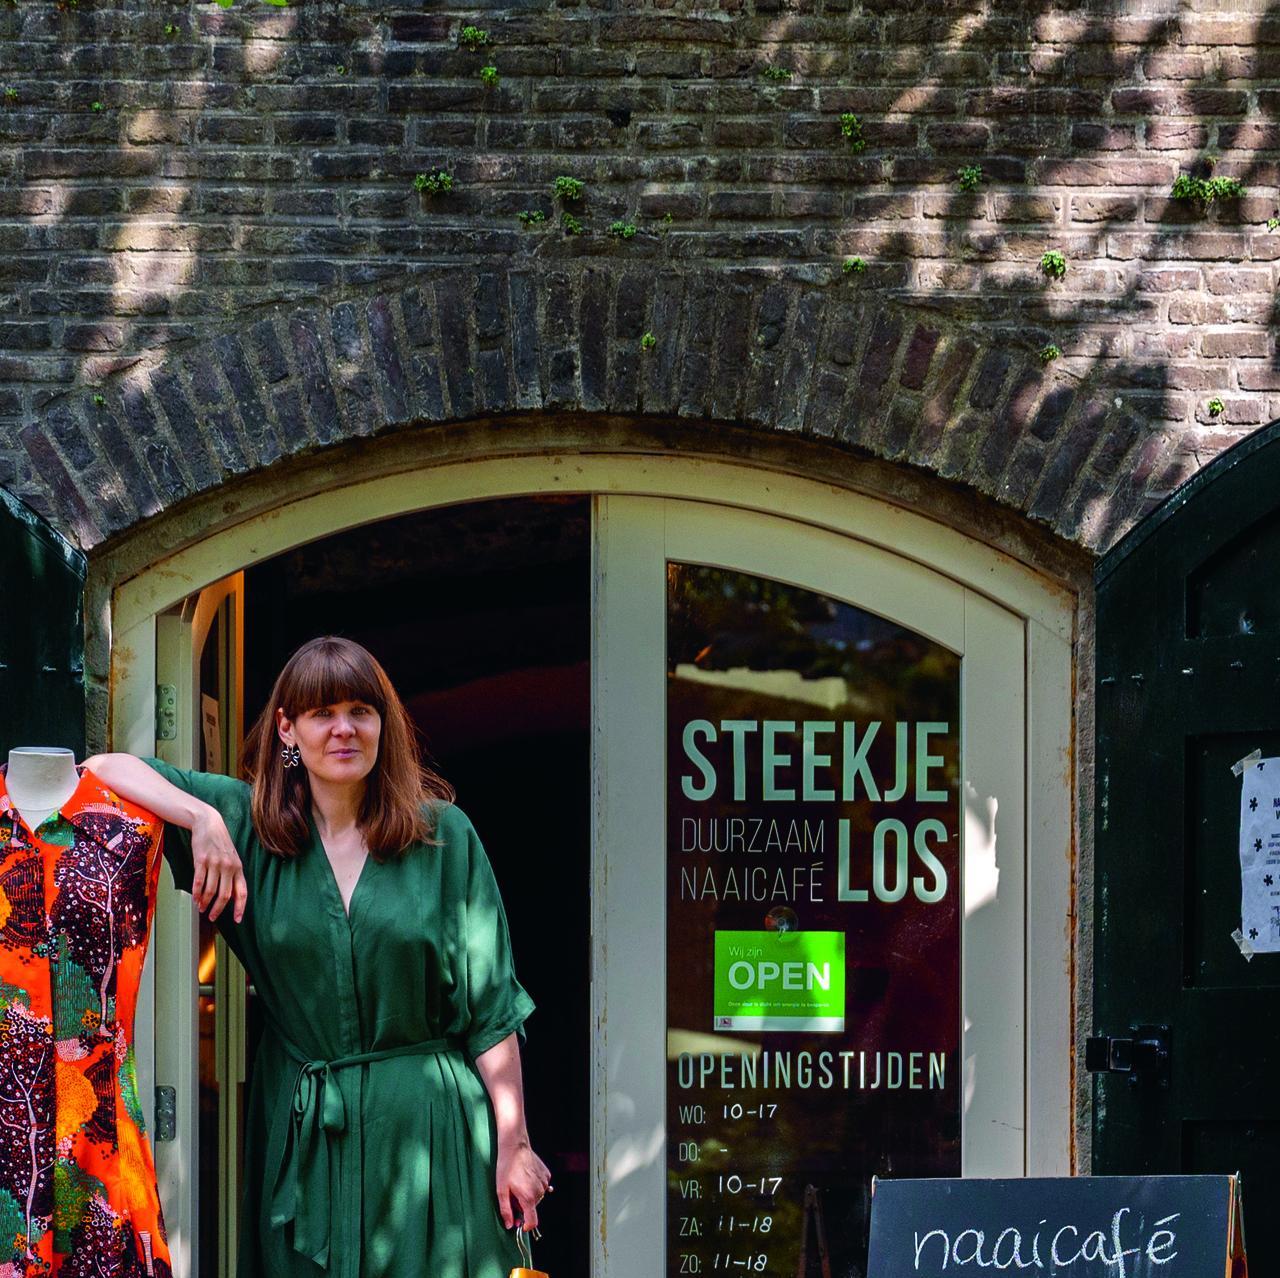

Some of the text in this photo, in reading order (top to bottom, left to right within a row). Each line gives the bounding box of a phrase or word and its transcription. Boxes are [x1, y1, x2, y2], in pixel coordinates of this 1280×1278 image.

[681, 719, 949, 802] STEEKJE
[681, 817, 824, 853] DUURZAAM
[837, 818, 949, 903] LOS
[681, 861, 824, 902] NAAICAFÉ
[728, 946, 763, 959] Wij zijn
[728, 961, 831, 991] OPEN
[678, 1051, 947, 1090] OPENINGSTIJDEN
[679, 1104, 778, 1124] WO: 10-17
[679, 1142, 701, 1162] DO:
[679, 1175, 783, 1199] VR: 10-17
[679, 1215, 772, 1236] ZA: 11-18
[679, 1254, 768, 1274] ZO: 11-18
